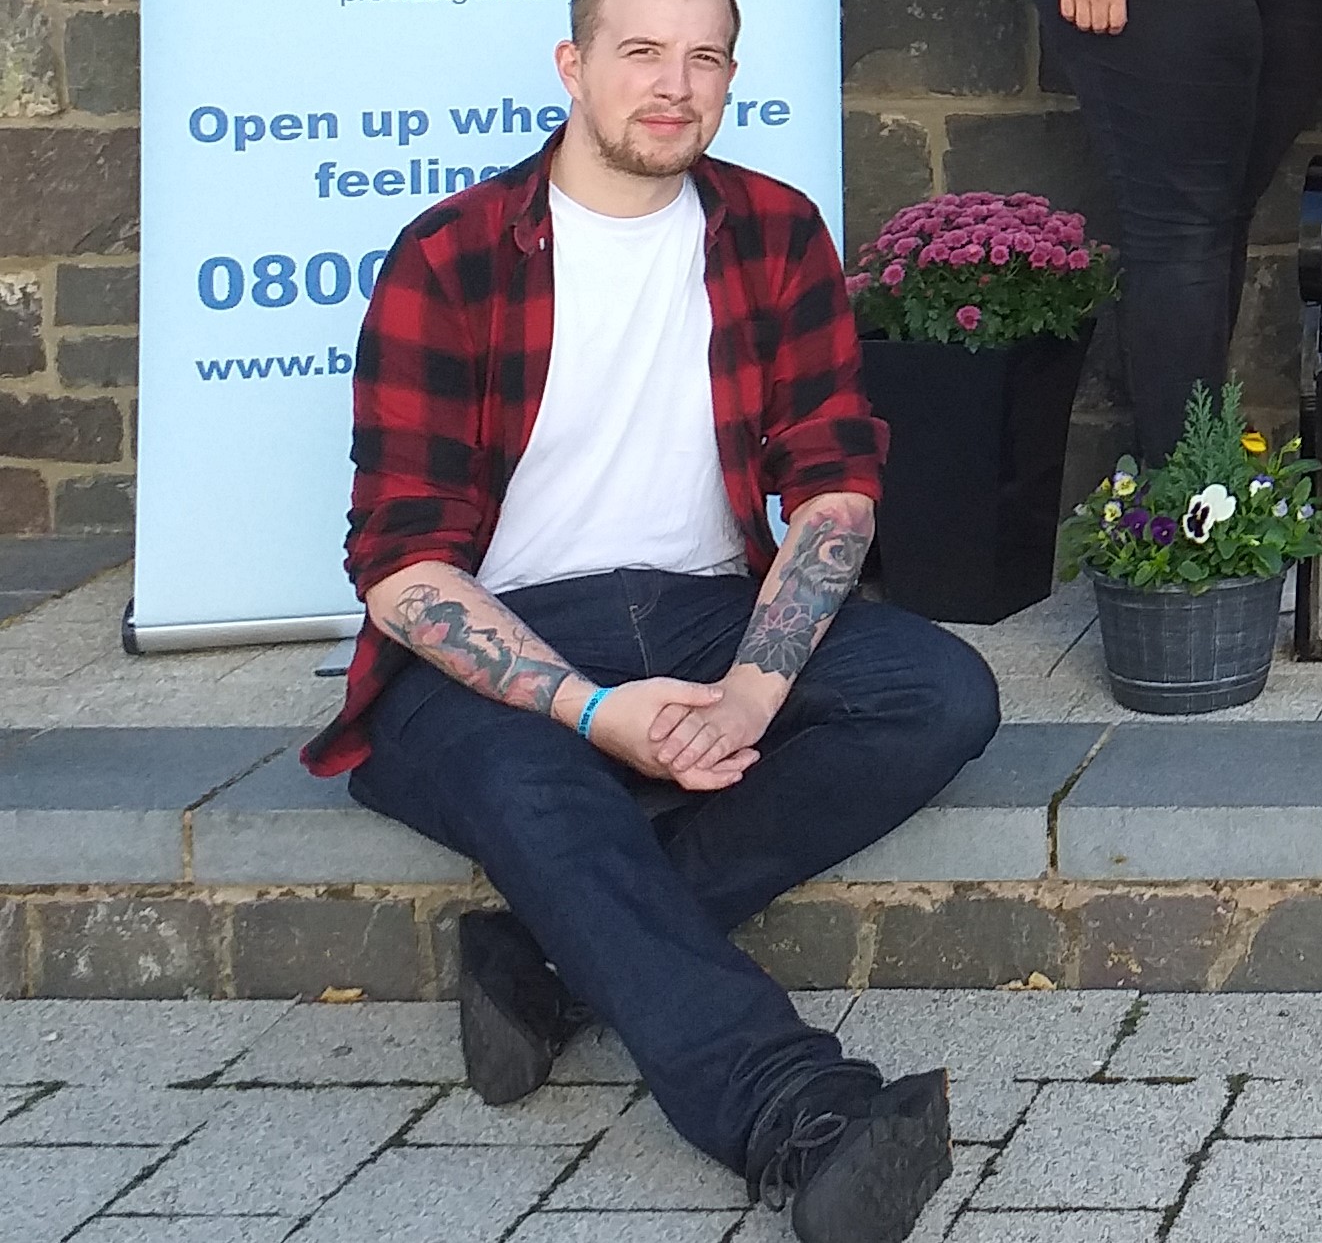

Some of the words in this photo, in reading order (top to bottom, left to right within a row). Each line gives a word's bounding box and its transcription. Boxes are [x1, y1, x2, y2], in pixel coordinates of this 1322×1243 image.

[189, 106, 338, 151] Open
[362, 110, 429, 146] up
[450, 100, 568, 133] whe
